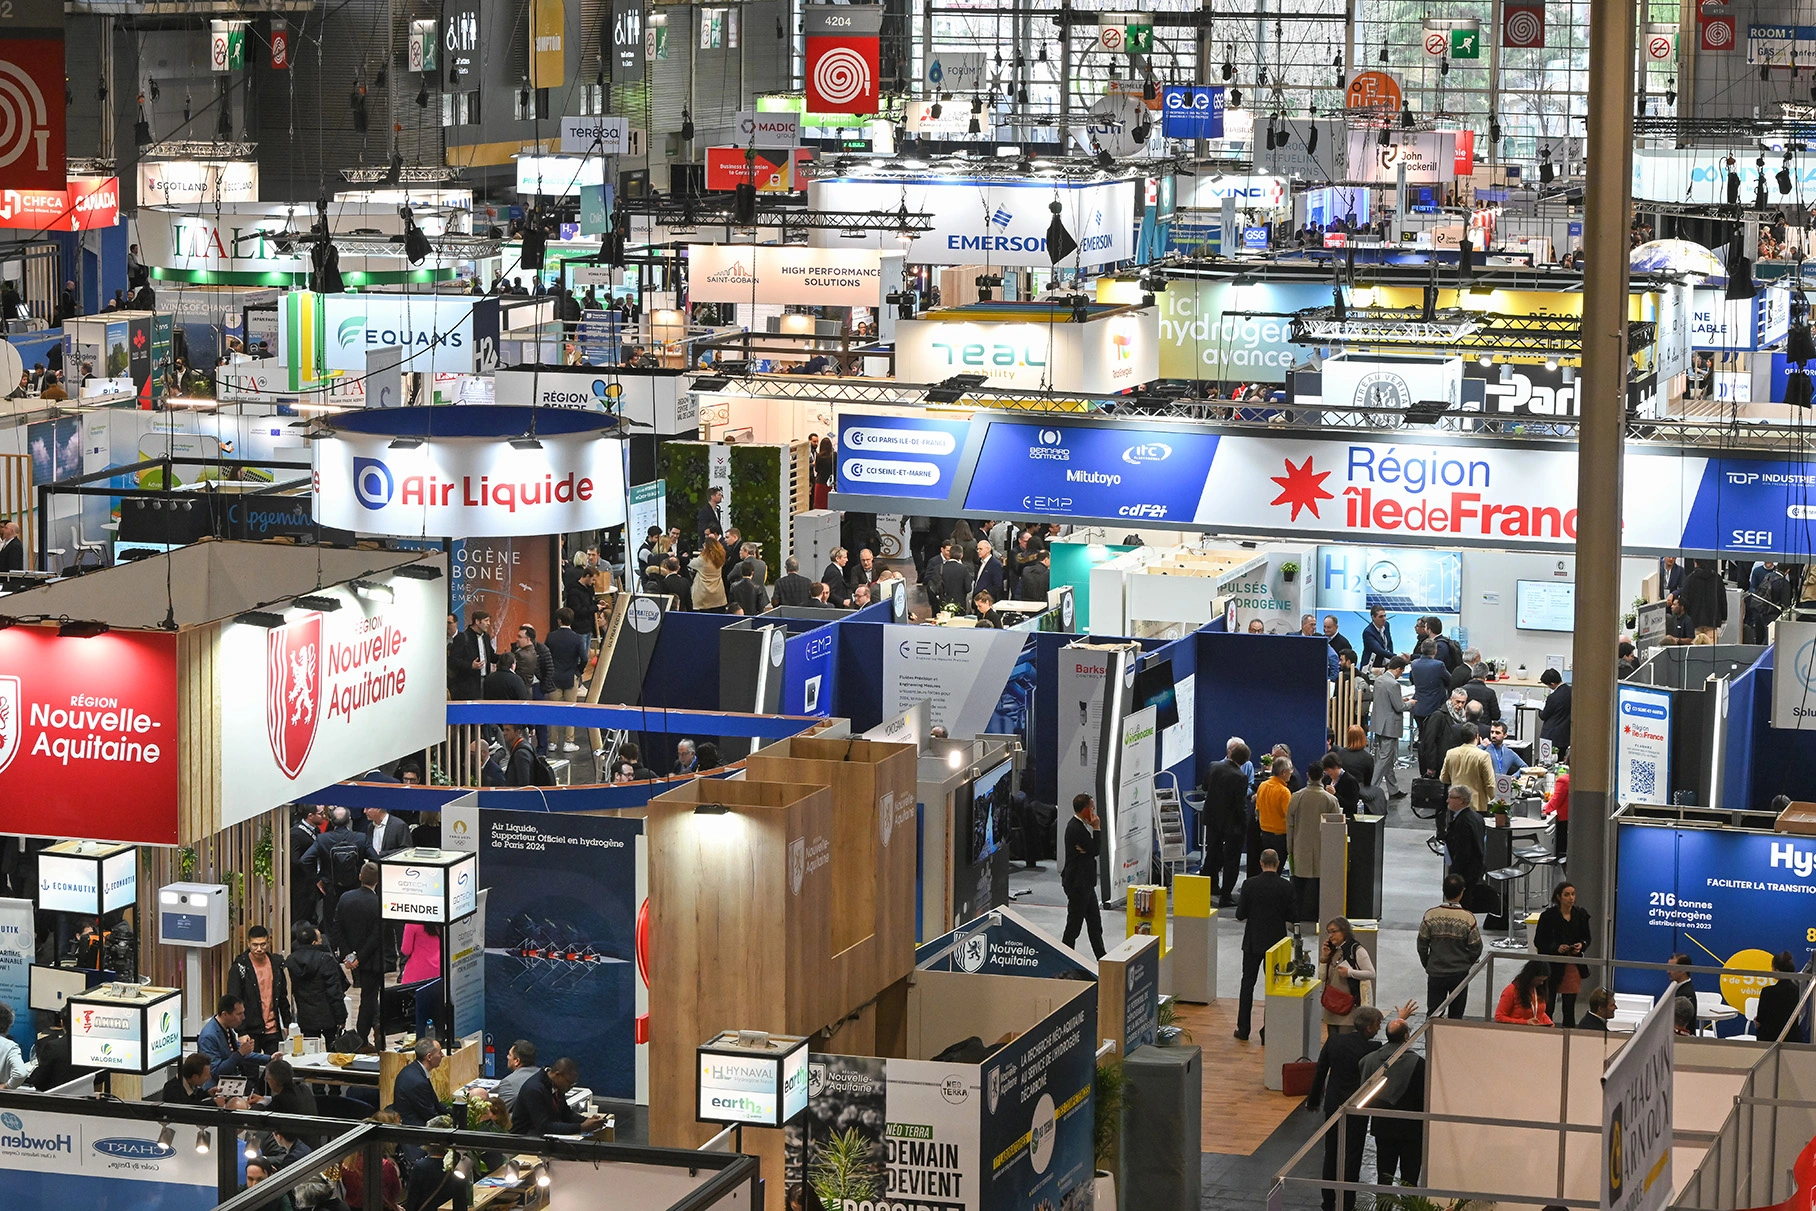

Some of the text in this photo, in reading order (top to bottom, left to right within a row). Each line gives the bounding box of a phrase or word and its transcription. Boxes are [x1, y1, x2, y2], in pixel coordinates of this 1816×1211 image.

[825, 16, 851, 27] 4204
[1751, 28, 1789, 38] ROOM
[948, 67, 976, 75] FORUM
[758, 123, 795, 132] MADIC
[1266, 153, 1319, 162] REFUELING
[1401, 151, 1422, 161] John
[1405, 161, 1437, 172] ockerill
[157, 181, 208, 191] SCOTLAND
[1212, 188, 1266, 197] VINCI
[23, 195, 63, 208] CHFCA
[75, 192, 117, 212] CANADA
[948, 235, 1048, 251] EMERSON
[1081, 233, 1113, 252] EMERSON
[782, 267, 881, 276] HIGH PERFORMANCE
[805, 278, 861, 286] SOLUTIONS
[1169, 291, 1200, 316] ici
[366, 330, 463, 347] EQUANS
[1203, 348, 1293, 366] avance
[543, 390, 588, 404] RÉGION
[899, 438, 946, 447] ILE-DE-FRANCE
[1030, 447, 1069, 455] BERNARD
[878, 468, 931, 478] SEINE-ET-MARNE
[1347, 446, 1490, 494] Région
[1067, 469, 1121, 486] Mitutoyo
[1726, 472, 1816, 484] TOP INDUSTRIE
[402, 475, 455, 507] Air
[464, 472, 593, 513] Liquide
[1035, 496, 1072, 507] EMP
[1732, 530, 1772, 545] SEFI
[457, 547, 520, 565] OGÈNE
[453, 564, 504, 580] BONÉ
[1236, 598, 1291, 610] DROGÈNE
[607, 612, 622, 648] ULTRATECH
[329, 625, 406, 677] Nouvelle-
[812, 635, 831, 654] EMP
[916, 641, 970, 656] EMP
[1076, 663, 1107, 673] Barks
[70, 694, 118, 709] RÉGION
[327, 666, 406, 724] Aquitaine
[30, 703, 161, 733] Nouvelle-
[1632, 723, 1649, 732] Région
[31, 735, 161, 766] Aquitaine
[505, 823, 539, 834] Liquide,
[491, 831, 536, 841] Supporteur
[537, 834, 566, 844] Officiel
[580, 837, 624, 848] hydrogène
[504, 841, 524, 849] Paris
[526, 842, 545, 851] 2024
[1770, 842, 1816, 877] Hy
[53, 882, 96, 894] ECONAUTIK
[398, 880, 427, 888] GOTECH
[1707, 878, 1752, 889] FACILITER
[1754, 882, 1765, 890] LA
[453, 890, 474, 905] GOTECH
[1650, 892, 1713, 909] 216 tonnes
[390, 902, 439, 915] ZHENDRE
[1649, 919, 1685, 928] distribuées
[989, 944, 1039, 956] Nouvelle-
[990, 954, 1039, 967] Aquitaine
[94, 1016, 130, 1030] AKIRA
[151, 1033, 179, 1051] VALOREM
[1020, 1010, 1085, 1068] LA RECHERCHE NÉO-AQUITAINE
[90, 1055, 123, 1064] VALOREM
[726, 1066, 773, 1079] HYNAVAL
[1021, 1072, 1028, 1085] AU
[1027, 1058, 1045, 1082] SERVICE
[1045, 1054, 1052, 1070] DE
[828, 1072, 872, 1083] Nouvelle-
[1624, 1036, 1671, 1131] CHAUVIN
[828, 1082, 872, 1093] Aquitaine
[943, 1087, 967, 1096] TERRA
[1020, 1070, 1047, 1104] DÉCARBONÉ
[886, 1123, 930, 1138] NÉO TERRA
[1624, 1090, 1669, 1181] ARNOUX
[886, 1139, 958, 1169] DEMAIN
[886, 1167, 962, 1198] DEVIENT
